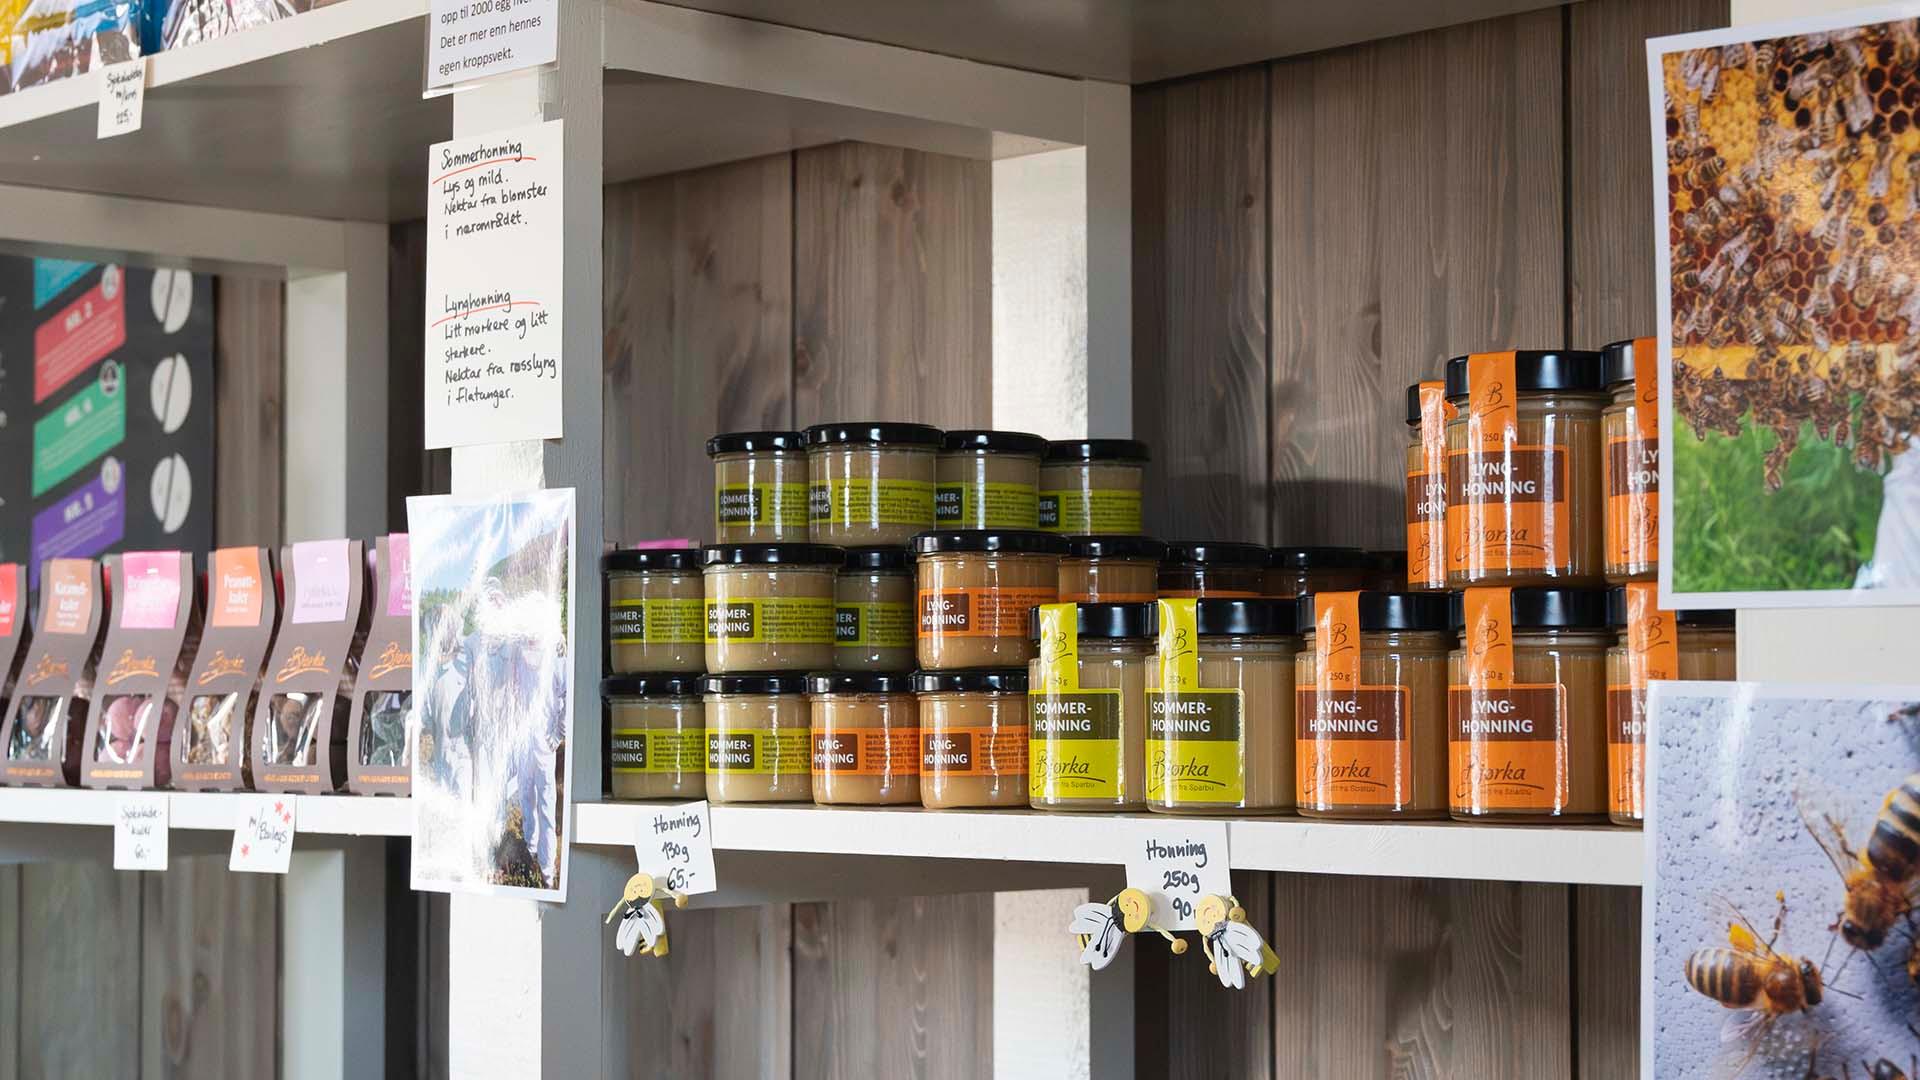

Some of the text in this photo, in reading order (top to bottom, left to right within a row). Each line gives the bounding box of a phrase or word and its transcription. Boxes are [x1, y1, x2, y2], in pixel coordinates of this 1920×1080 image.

[441, 11, 458, 25] opp
[460, 6, 469, 19] til
[471, 2, 493, 16] 2000
[495, 0, 511, 12] egg
[440, 16, 542, 49] Det er mer enn hennes
[439, 47, 514, 76] egen kroppsvekt.
[441, 140, 522, 170] Sommerhonning
[444, 168, 509, 200] Lys og mild.
[444, 181, 548, 215] Nektar fra blomster
[444, 224, 449, 240] i
[445, 290, 512, 320] Lynghonning
[445, 323, 462, 340] Litt
[515, 318, 527, 340] og
[531, 310, 549, 328] litt
[445, 343, 492, 363] sterkere.
[445, 367, 481, 384] Nektar
[486, 362, 505, 376] fra
[447, 386, 514, 408] i Flatanger.
[1483, 432, 1499, 442] 250
[1425, 484, 1447, 497] LYN
[1462, 481, 1536, 497] HONNNG
[935, 493, 960, 503] MER-
[927, 600, 954, 611] LYG-
[709, 609, 751, 620] SOMER-
[922, 614, 965, 625] HONING
[709, 622, 750, 632] HONING
[1036, 702, 1092, 715] SOMMER-
[1153, 701, 1212, 714] SOMMER-
[1319, 700, 1362, 713] LYNG-
[1473, 700, 1516, 713] LYNG-
[1036, 719, 1091, 732] HONNING
[1152, 719, 1211, 732] HONNING
[1309, 719, 1378, 732] HONNING
[1462, 719, 1533, 733] HONNING
[710, 739, 751, 750] SOMER-
[710, 753, 751, 763] HONING
[653, 812, 701, 838] Honning
[1146, 839, 1208, 868] Honning
[1162, 870, 1200, 893] 250g
